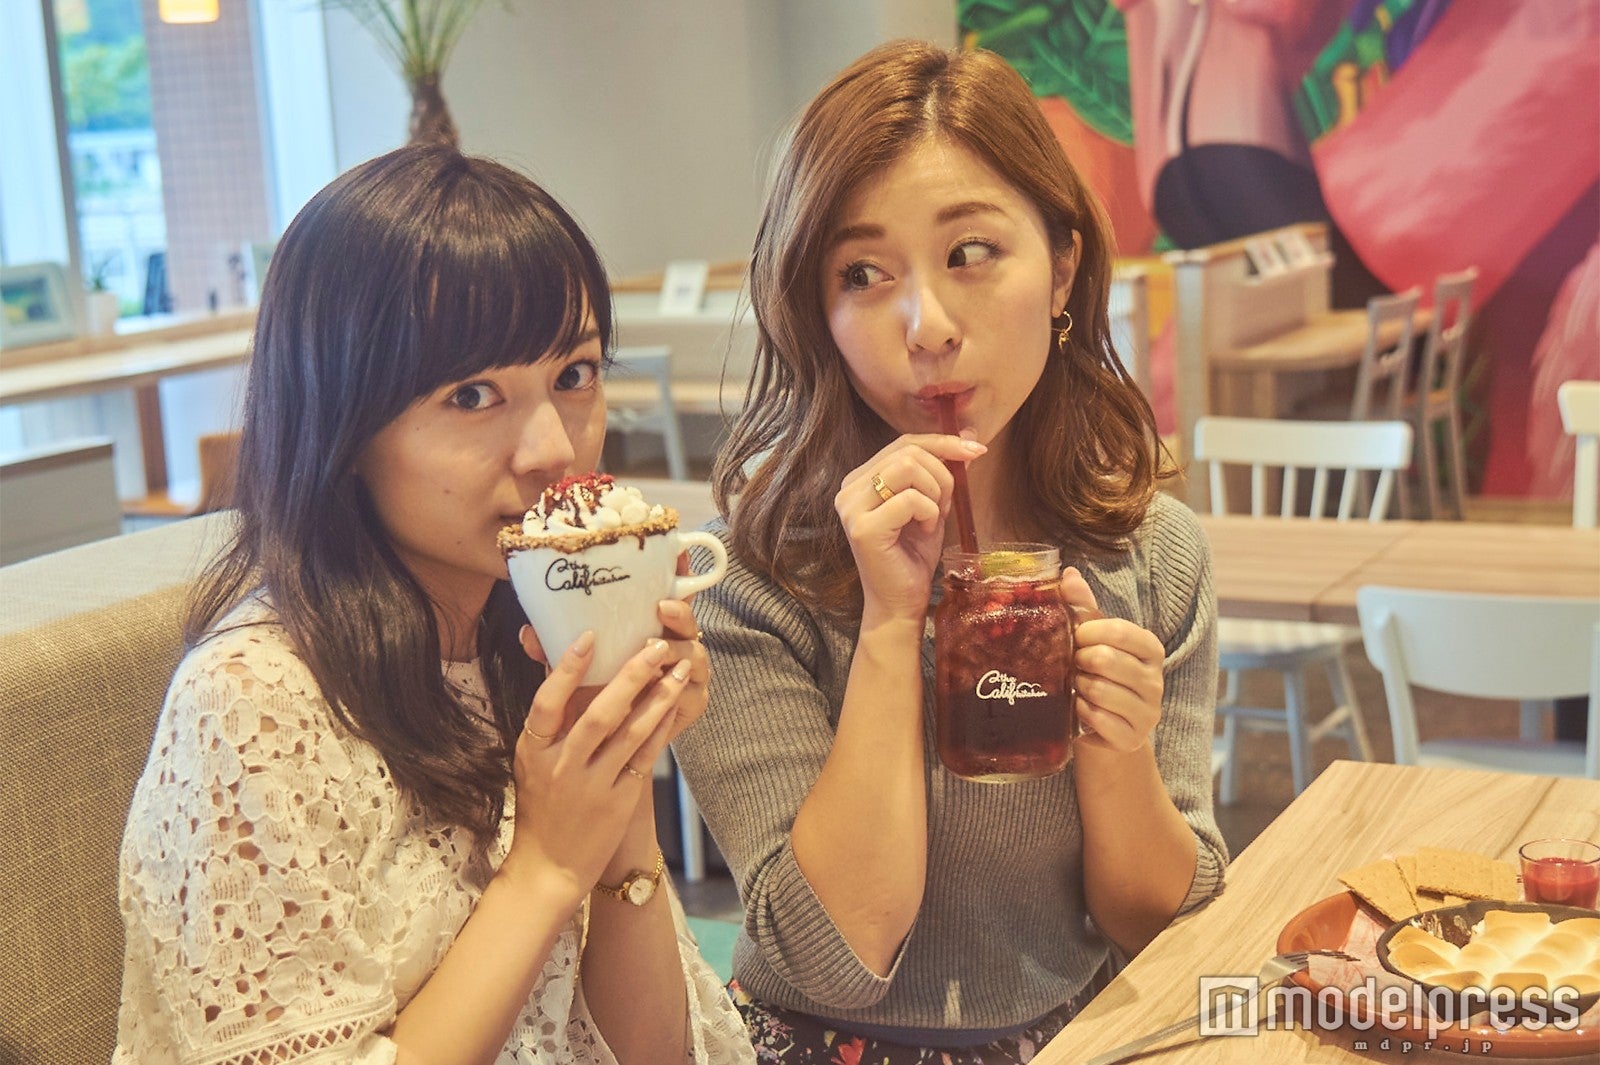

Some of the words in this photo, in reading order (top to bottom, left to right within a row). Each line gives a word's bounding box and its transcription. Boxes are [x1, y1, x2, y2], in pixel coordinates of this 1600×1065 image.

[545, 558, 592, 596] Calif
[976, 669, 1016, 706] Calif
[999, 673, 1017, 683] the
